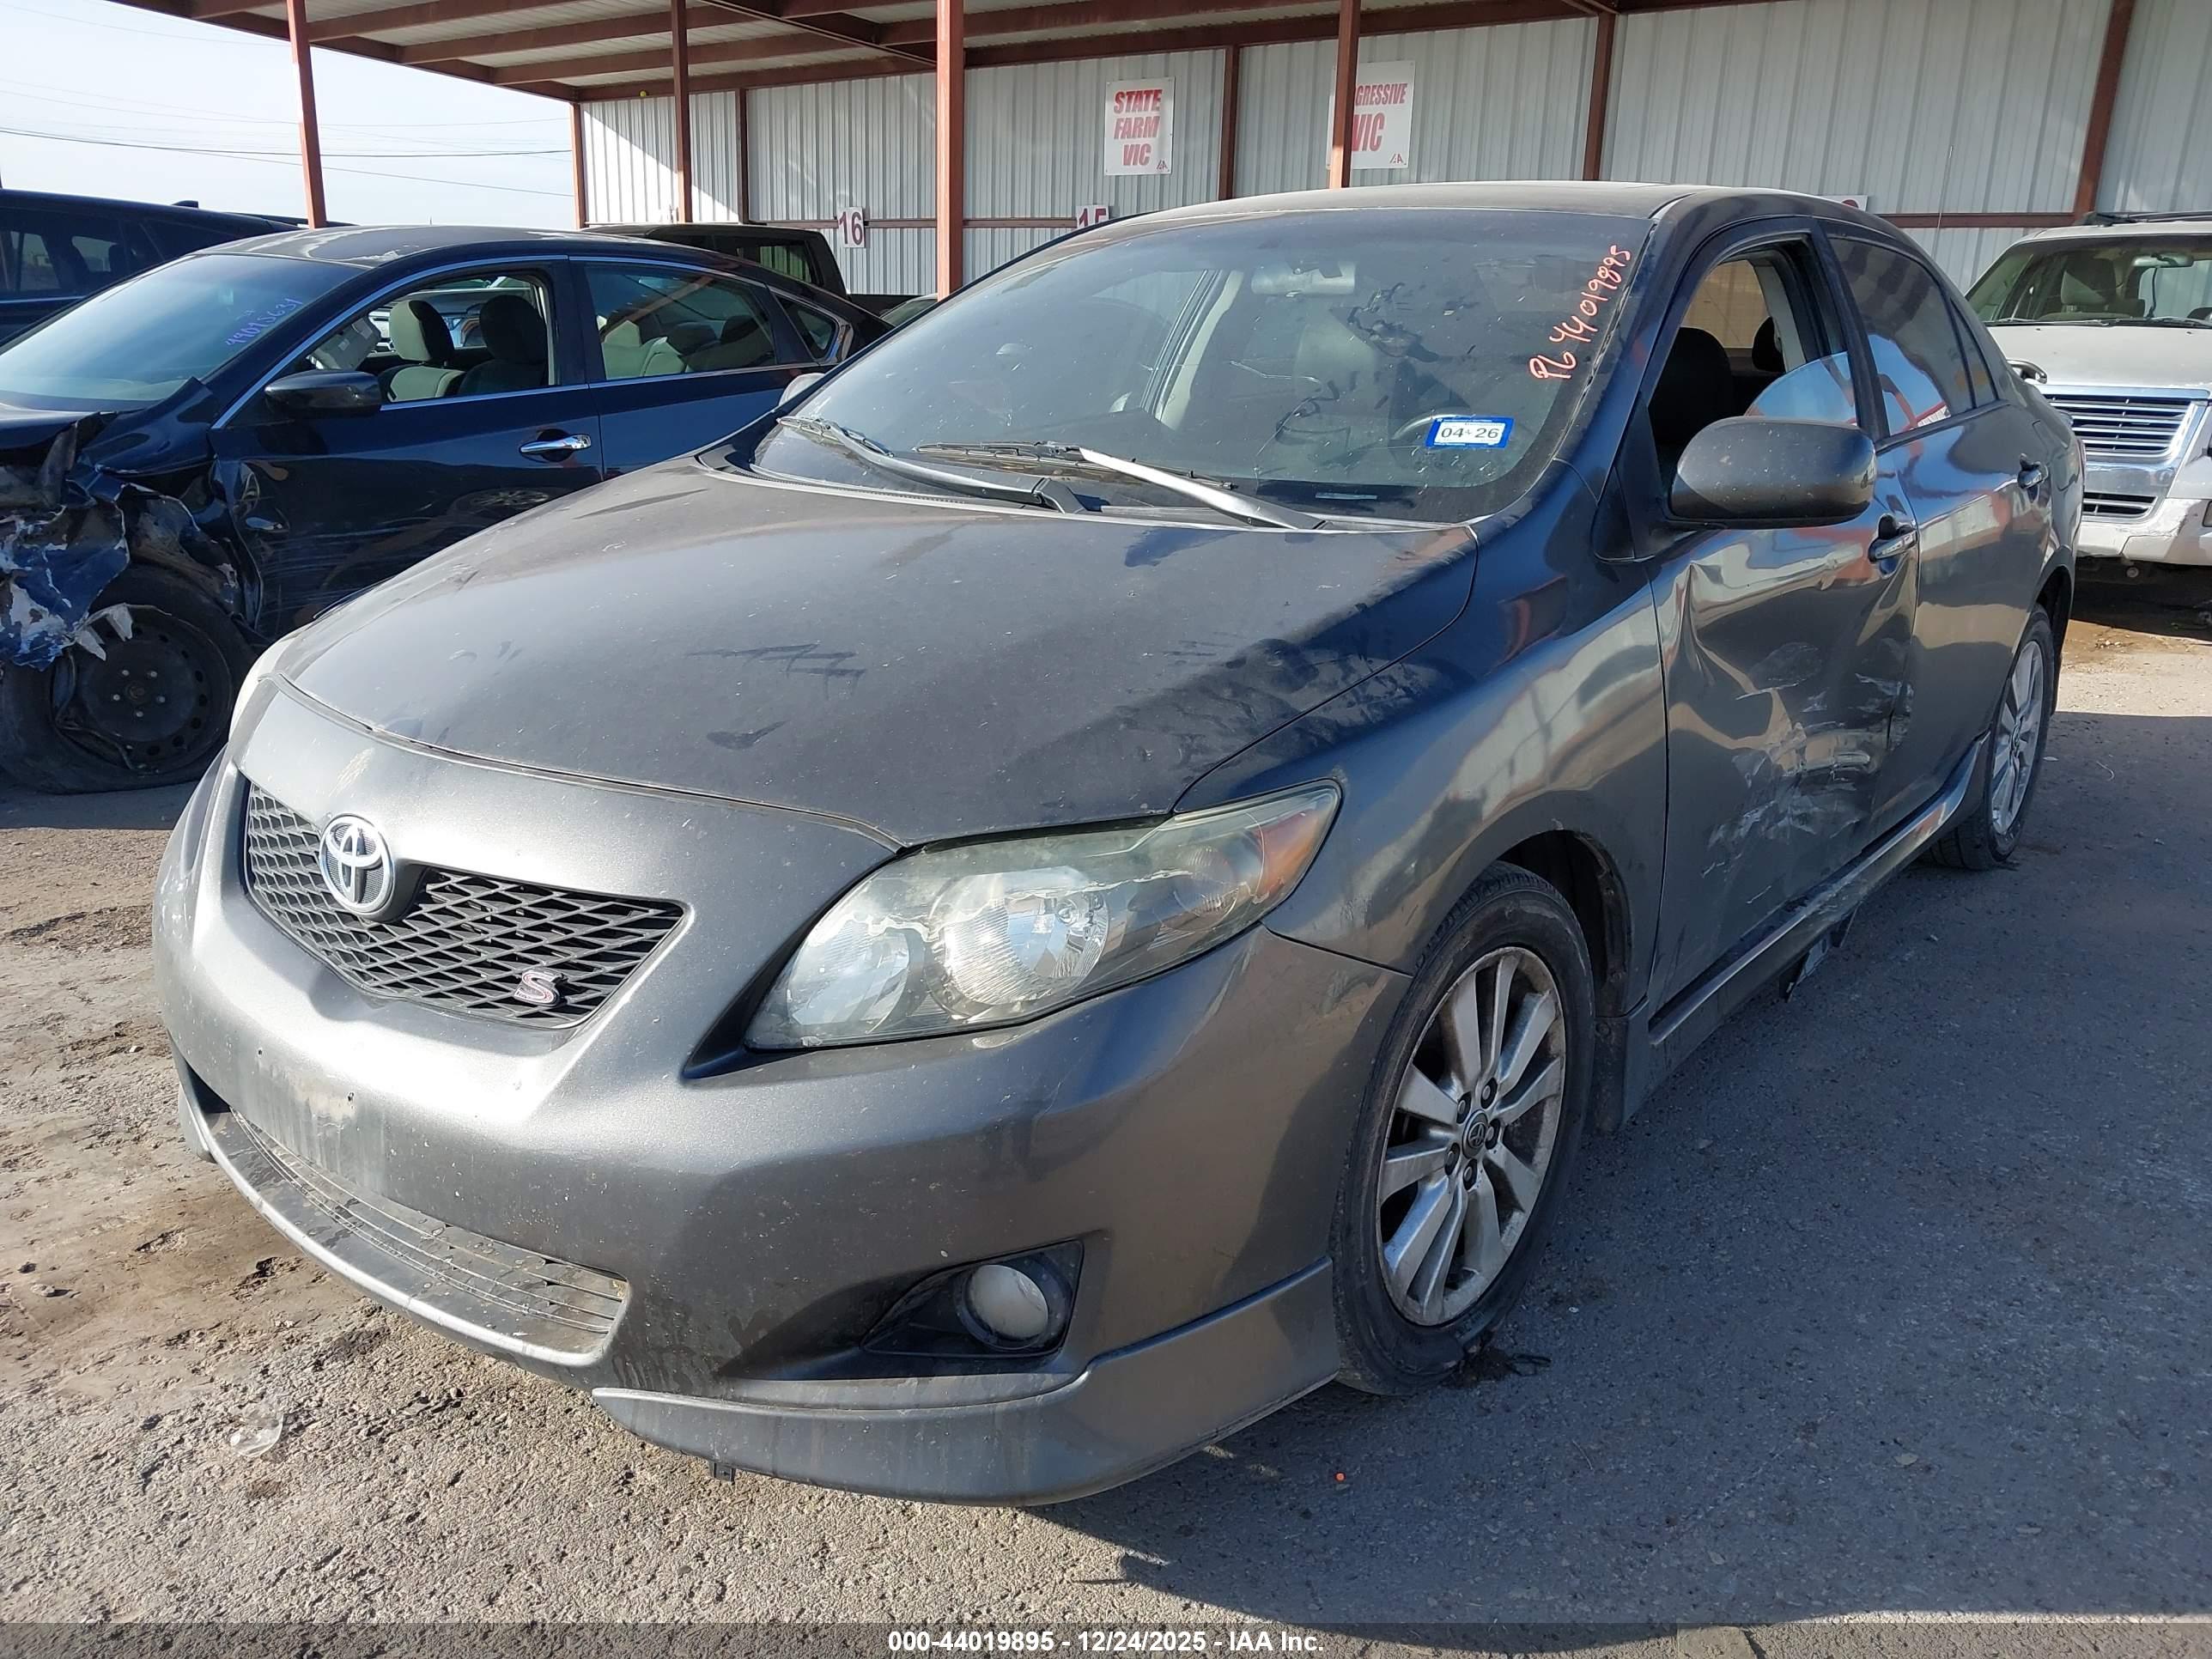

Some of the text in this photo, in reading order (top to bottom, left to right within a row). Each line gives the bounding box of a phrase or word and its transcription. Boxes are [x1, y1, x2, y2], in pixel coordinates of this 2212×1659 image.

[1114, 89, 1163, 113] STATE
[1355, 83, 1408, 106] GRESSIVE
[1114, 116, 1160, 139] FARM
[1352, 112, 1385, 151] VIC
[1123, 143, 1152, 166] VIC
[839, 211, 863, 246] 16
[1549, 245, 1631, 342] 44019895
[1441, 428, 1499, 438] 04 26
[514, 970, 555, 1004] S
